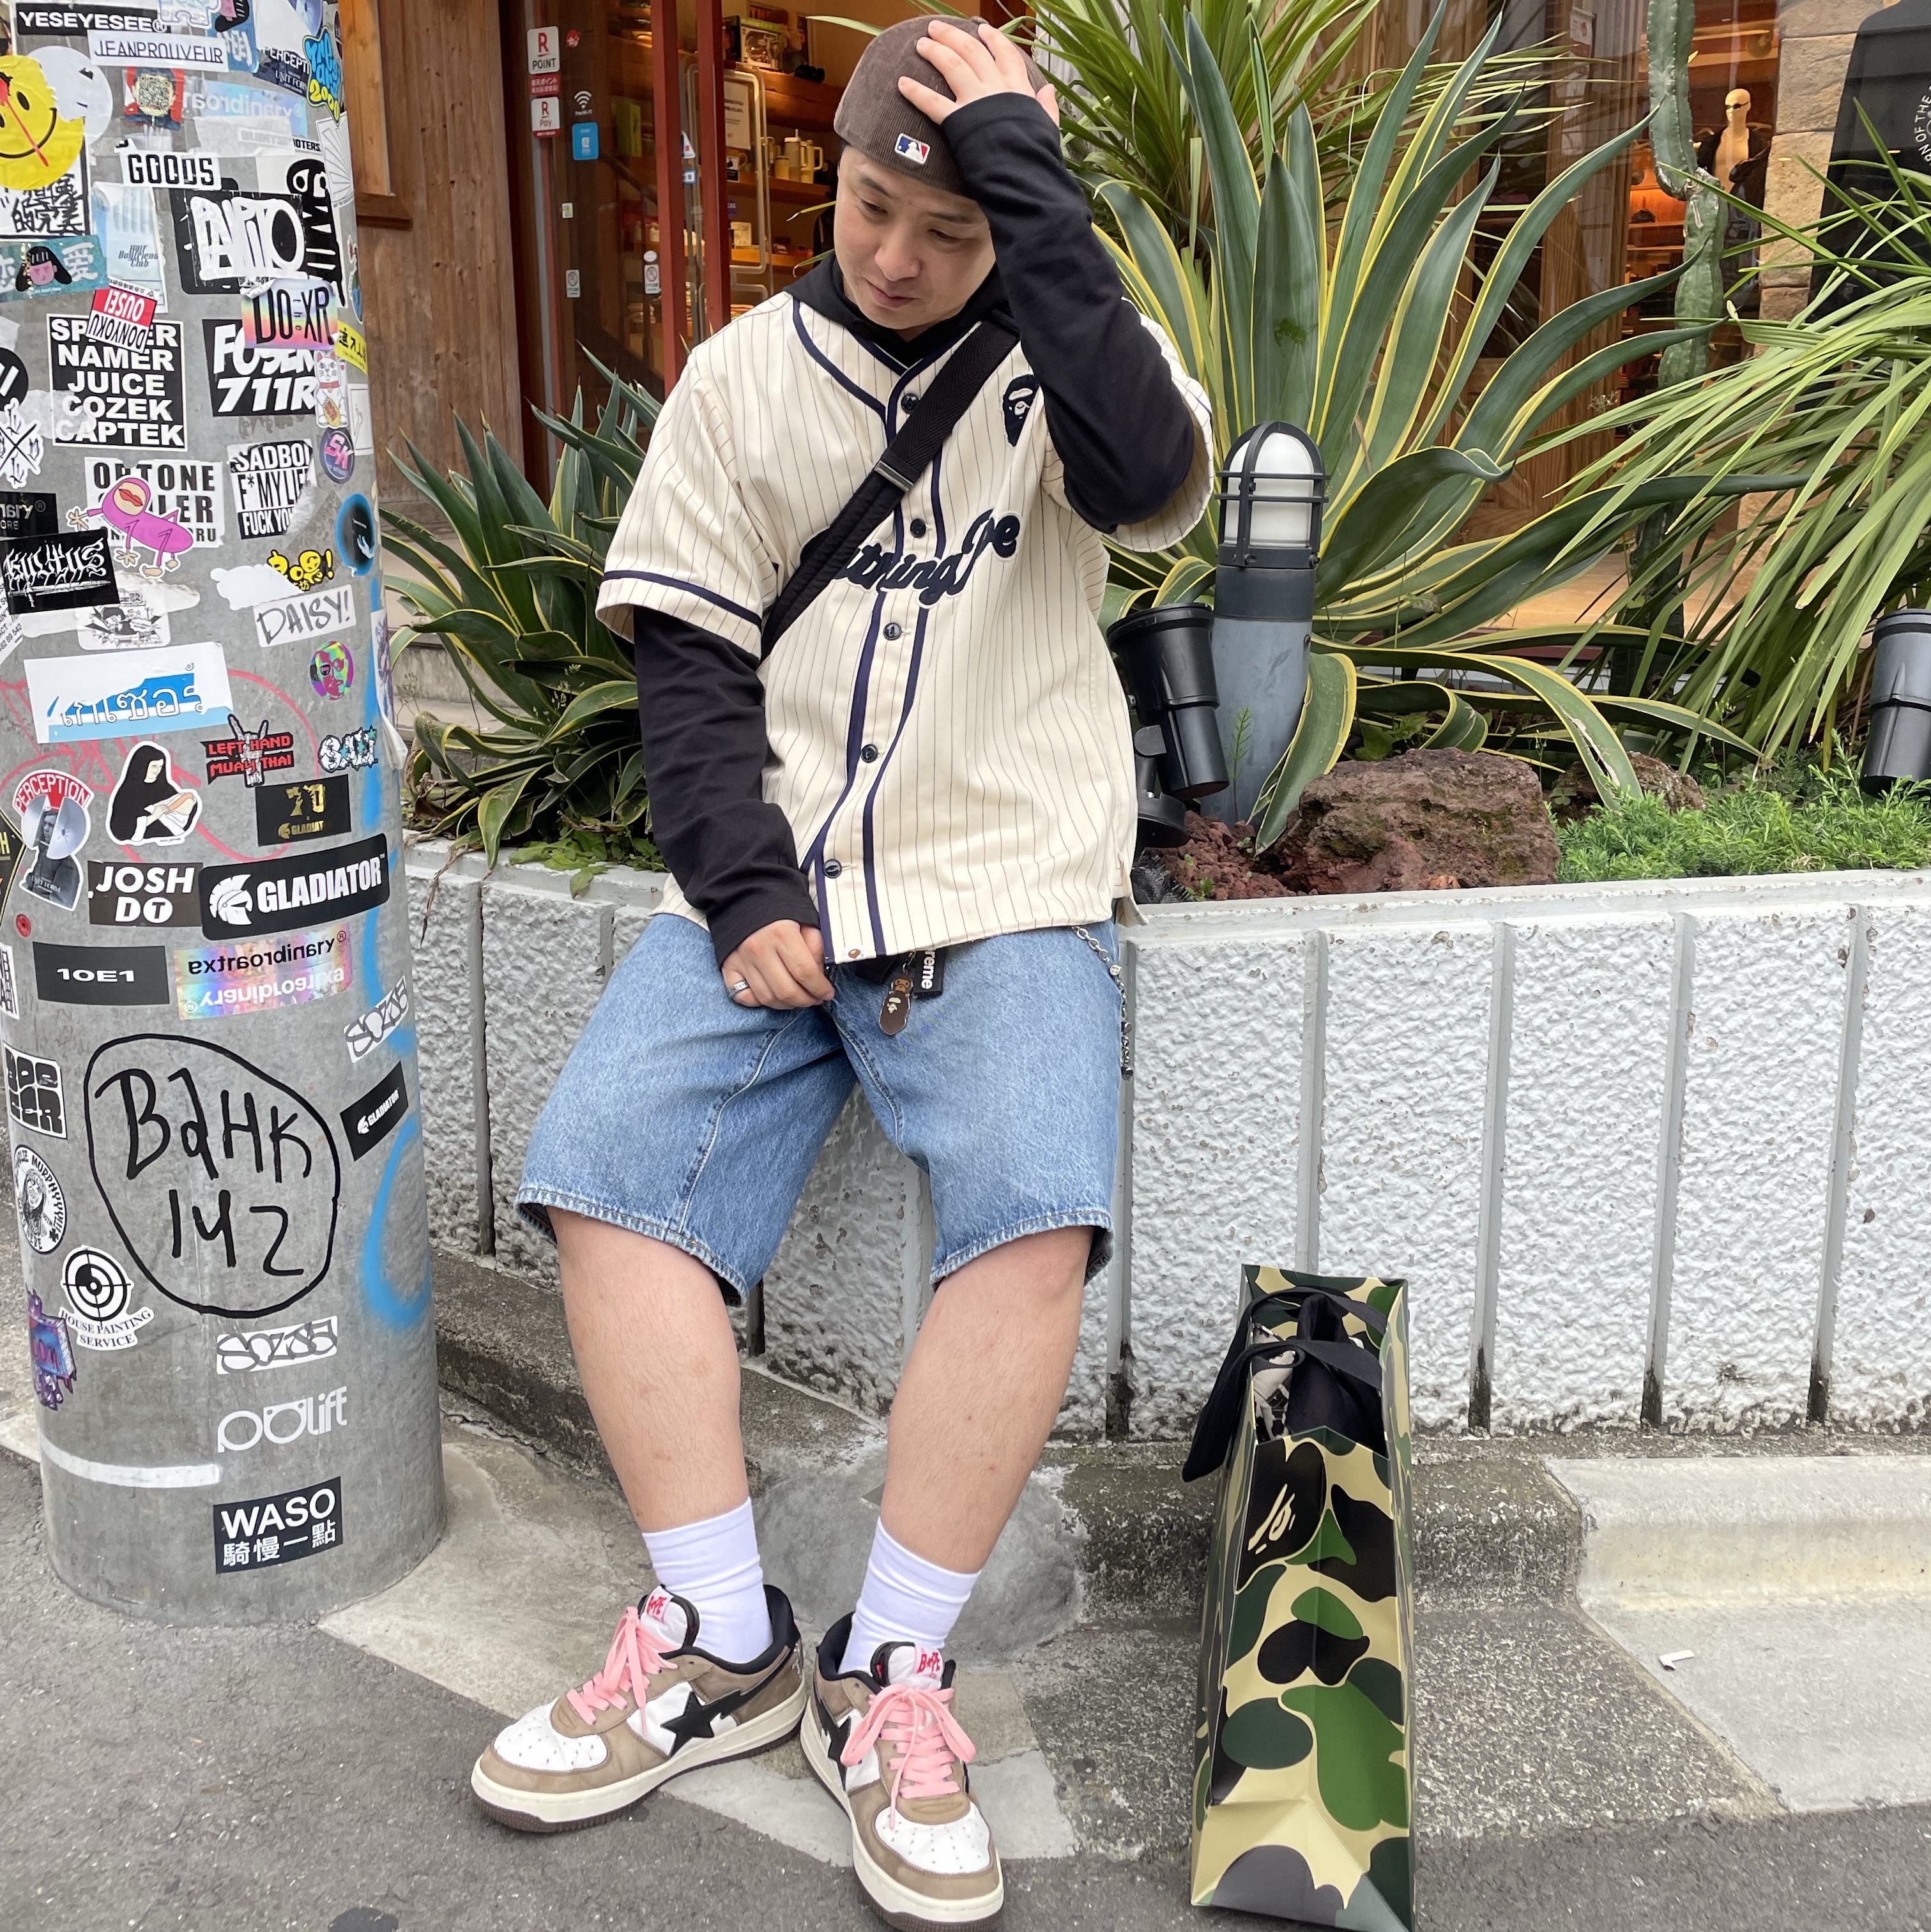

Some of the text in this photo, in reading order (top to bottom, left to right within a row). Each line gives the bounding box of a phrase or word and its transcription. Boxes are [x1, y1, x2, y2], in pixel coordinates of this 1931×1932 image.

[538, 32, 549, 52] R
[532, 58, 556, 70] POINT
[542, 101, 549, 116] R
[1914, 95, 1931, 123] THE
[540, 119, 552, 128] Pay
[1914, 126, 1927, 142] OF
[128, 154, 215, 186] GOODS
[118, 251, 158, 262] Boyfriend
[130, 245, 148, 256] Half
[131, 259, 149, 268] Club
[103, 289, 144, 321] OUSEI
[88, 314, 147, 350] DONYOKU
[57, 344, 175, 372] NAMER
[67, 370, 165, 397] JUICE
[62, 395, 174, 422] COZEK
[56, 419, 185, 446] CAPTEK
[242, 510, 275, 536] FUCK
[257, 590, 350, 645] DAISY!
[208, 734, 291, 756] LEFT HAND
[210, 754, 292, 777] MUAY THAI
[15, 773, 90, 812] PERCEPTION
[96, 865, 195, 894] JOSH
[367, 1088, 400, 1127] GLADIATOR
[169, 1189, 304, 1276] 142
[61, 1310, 151, 1334] HOUSE PAINTING
[80, 1334, 135, 1348] SERVICE
[220, 1488, 336, 1540] WASO
[222, 1519, 336, 1567] 騎慢一點
